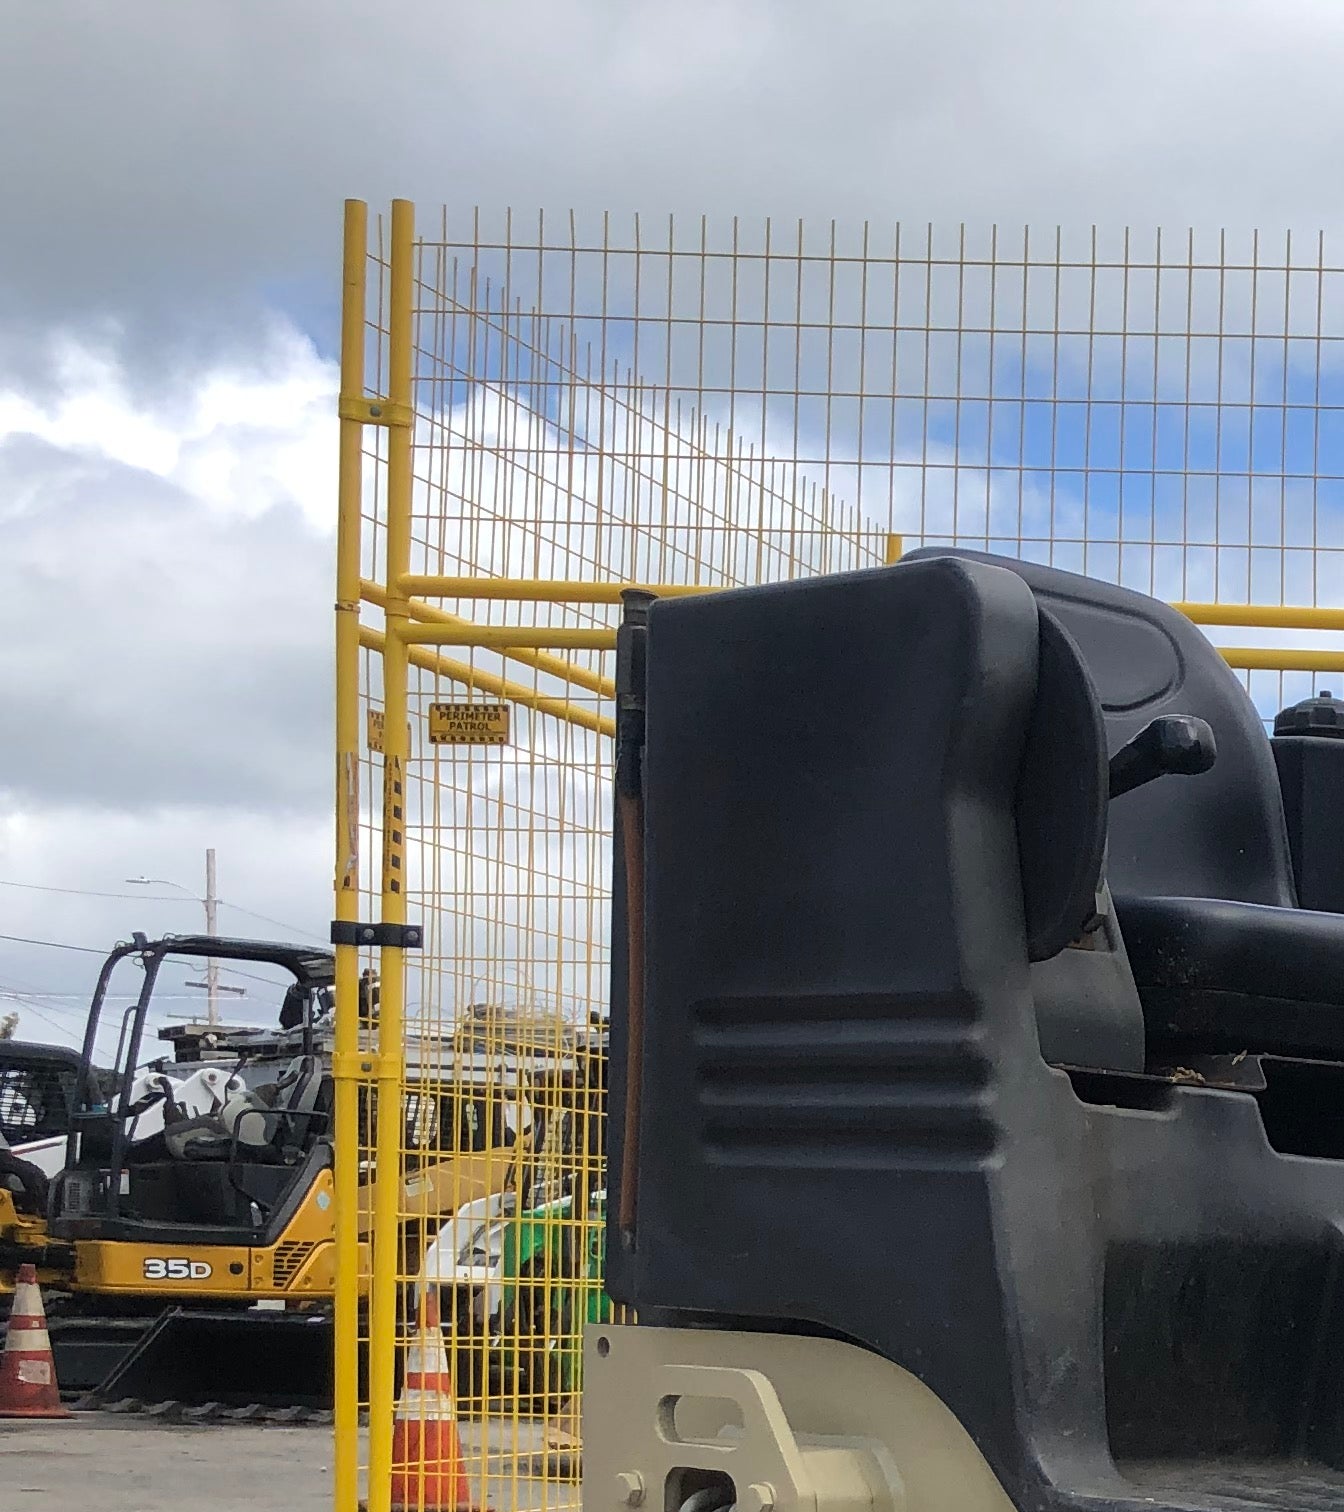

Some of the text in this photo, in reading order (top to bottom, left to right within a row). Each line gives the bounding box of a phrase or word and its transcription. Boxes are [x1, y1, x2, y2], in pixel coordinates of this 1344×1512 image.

[440, 711, 501, 721] PERIMETER
[449, 721, 491, 731] PATROL
[144, 1257, 213, 1279] 35D
